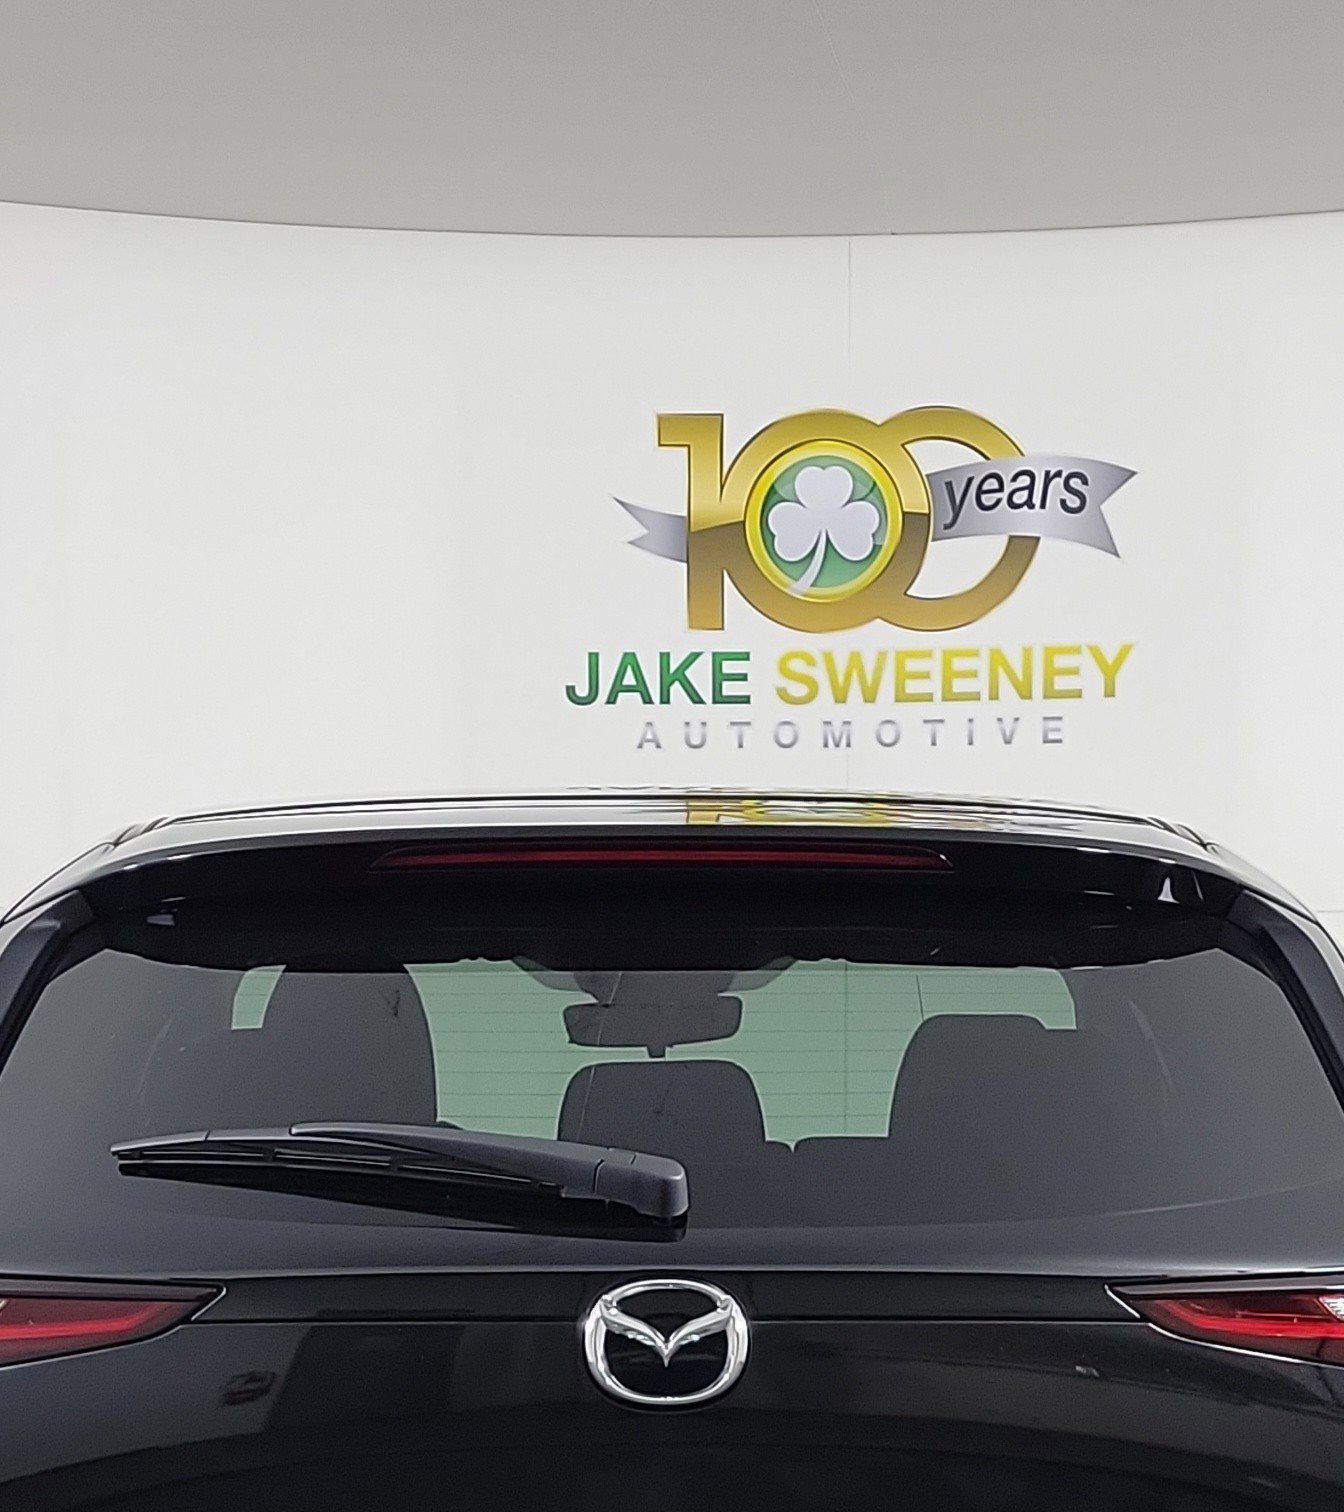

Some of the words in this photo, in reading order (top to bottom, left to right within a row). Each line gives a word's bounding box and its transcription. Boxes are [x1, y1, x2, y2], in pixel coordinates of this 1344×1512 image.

[657, 405, 1041, 634] 100
[942, 464, 1090, 531] years
[564, 650, 752, 707] JAKE
[775, 643, 1135, 705] SWEENEY
[636, 715, 1065, 750] AUTOMOTIVE
